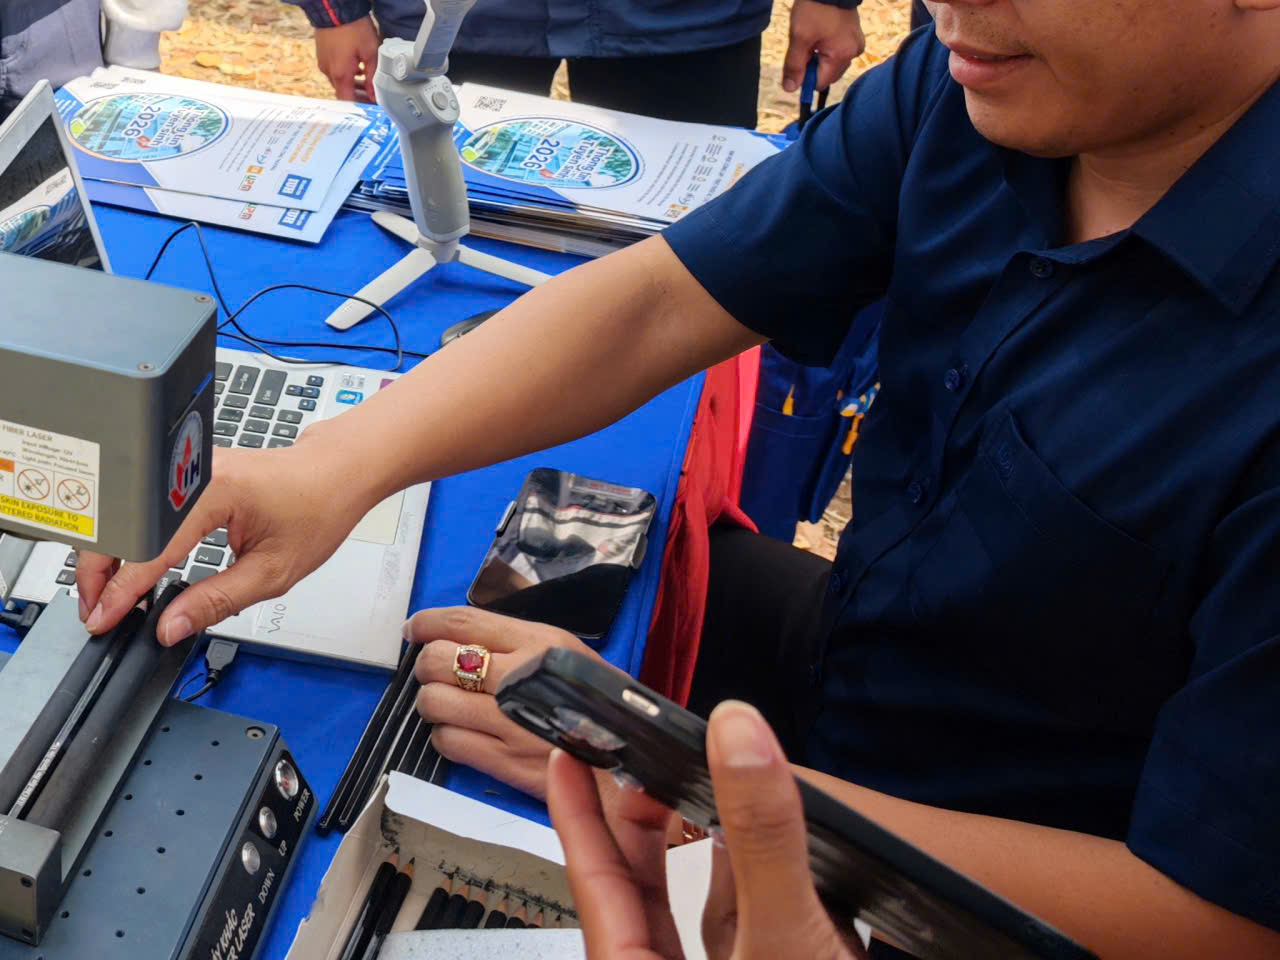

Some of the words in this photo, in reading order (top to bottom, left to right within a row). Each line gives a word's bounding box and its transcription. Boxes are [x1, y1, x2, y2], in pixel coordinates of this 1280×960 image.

[124, 105, 161, 137] 2026
[523, 138, 561, 169] 2026
[2, 424, 25, 436] FIBER
[27, 429, 53, 442] LASER
[0, 494, 19, 507] SKIN
[21, 499, 66, 518] EXPOSURE
[68, 511, 78, 522] TO
[34, 513, 79, 532] RADIATION
[268, 603, 287, 634] VAIO
[294, 788, 310, 823] POWER
[278, 840, 288, 857] UP
[258, 868, 276, 905] DOWN
[235, 902, 256, 953] LASER
